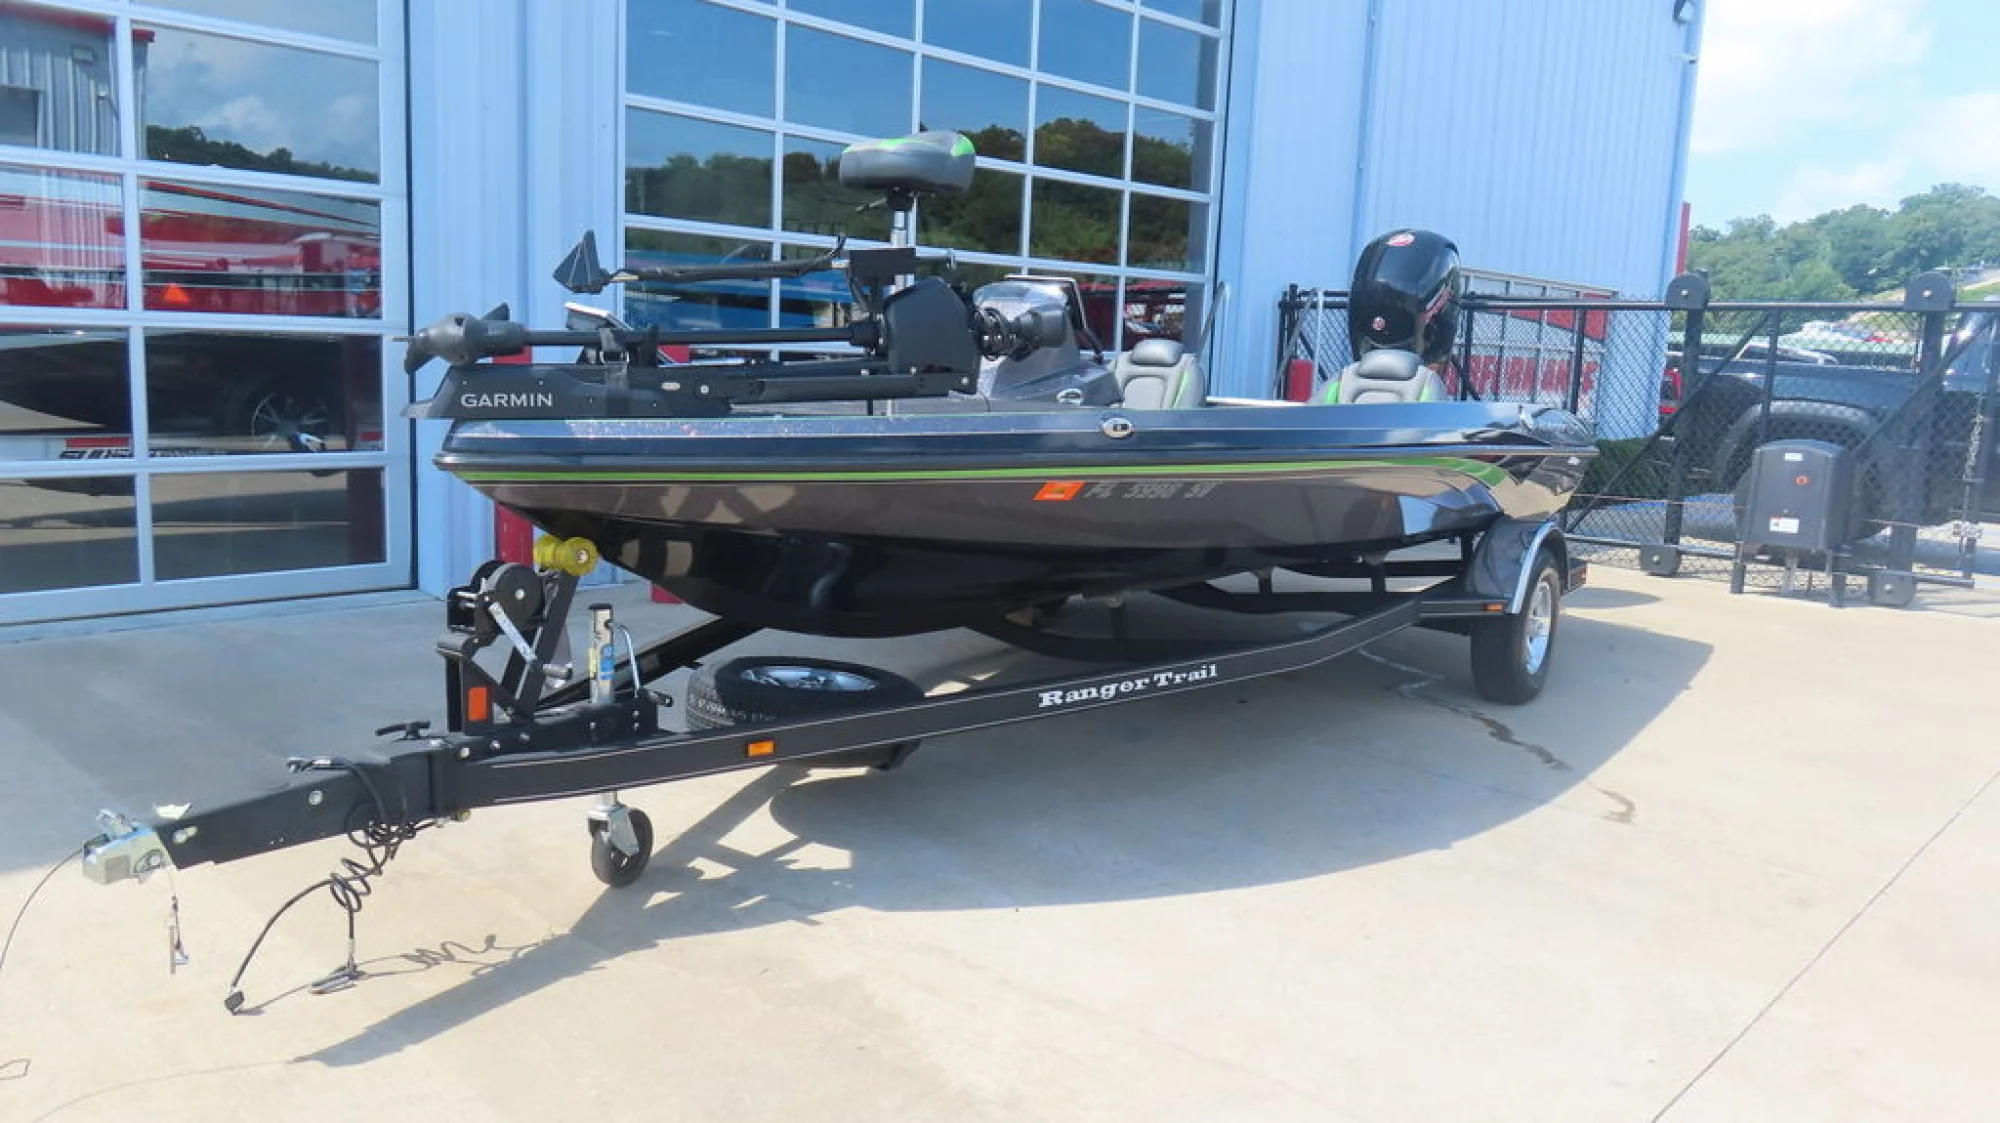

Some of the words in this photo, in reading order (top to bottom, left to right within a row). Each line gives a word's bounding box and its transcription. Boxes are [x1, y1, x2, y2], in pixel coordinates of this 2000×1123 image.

[460, 392, 554, 408] GARMIN
[1038, 677, 1150, 708] Ranger
[1153, 663, 1218, 688] Trail
